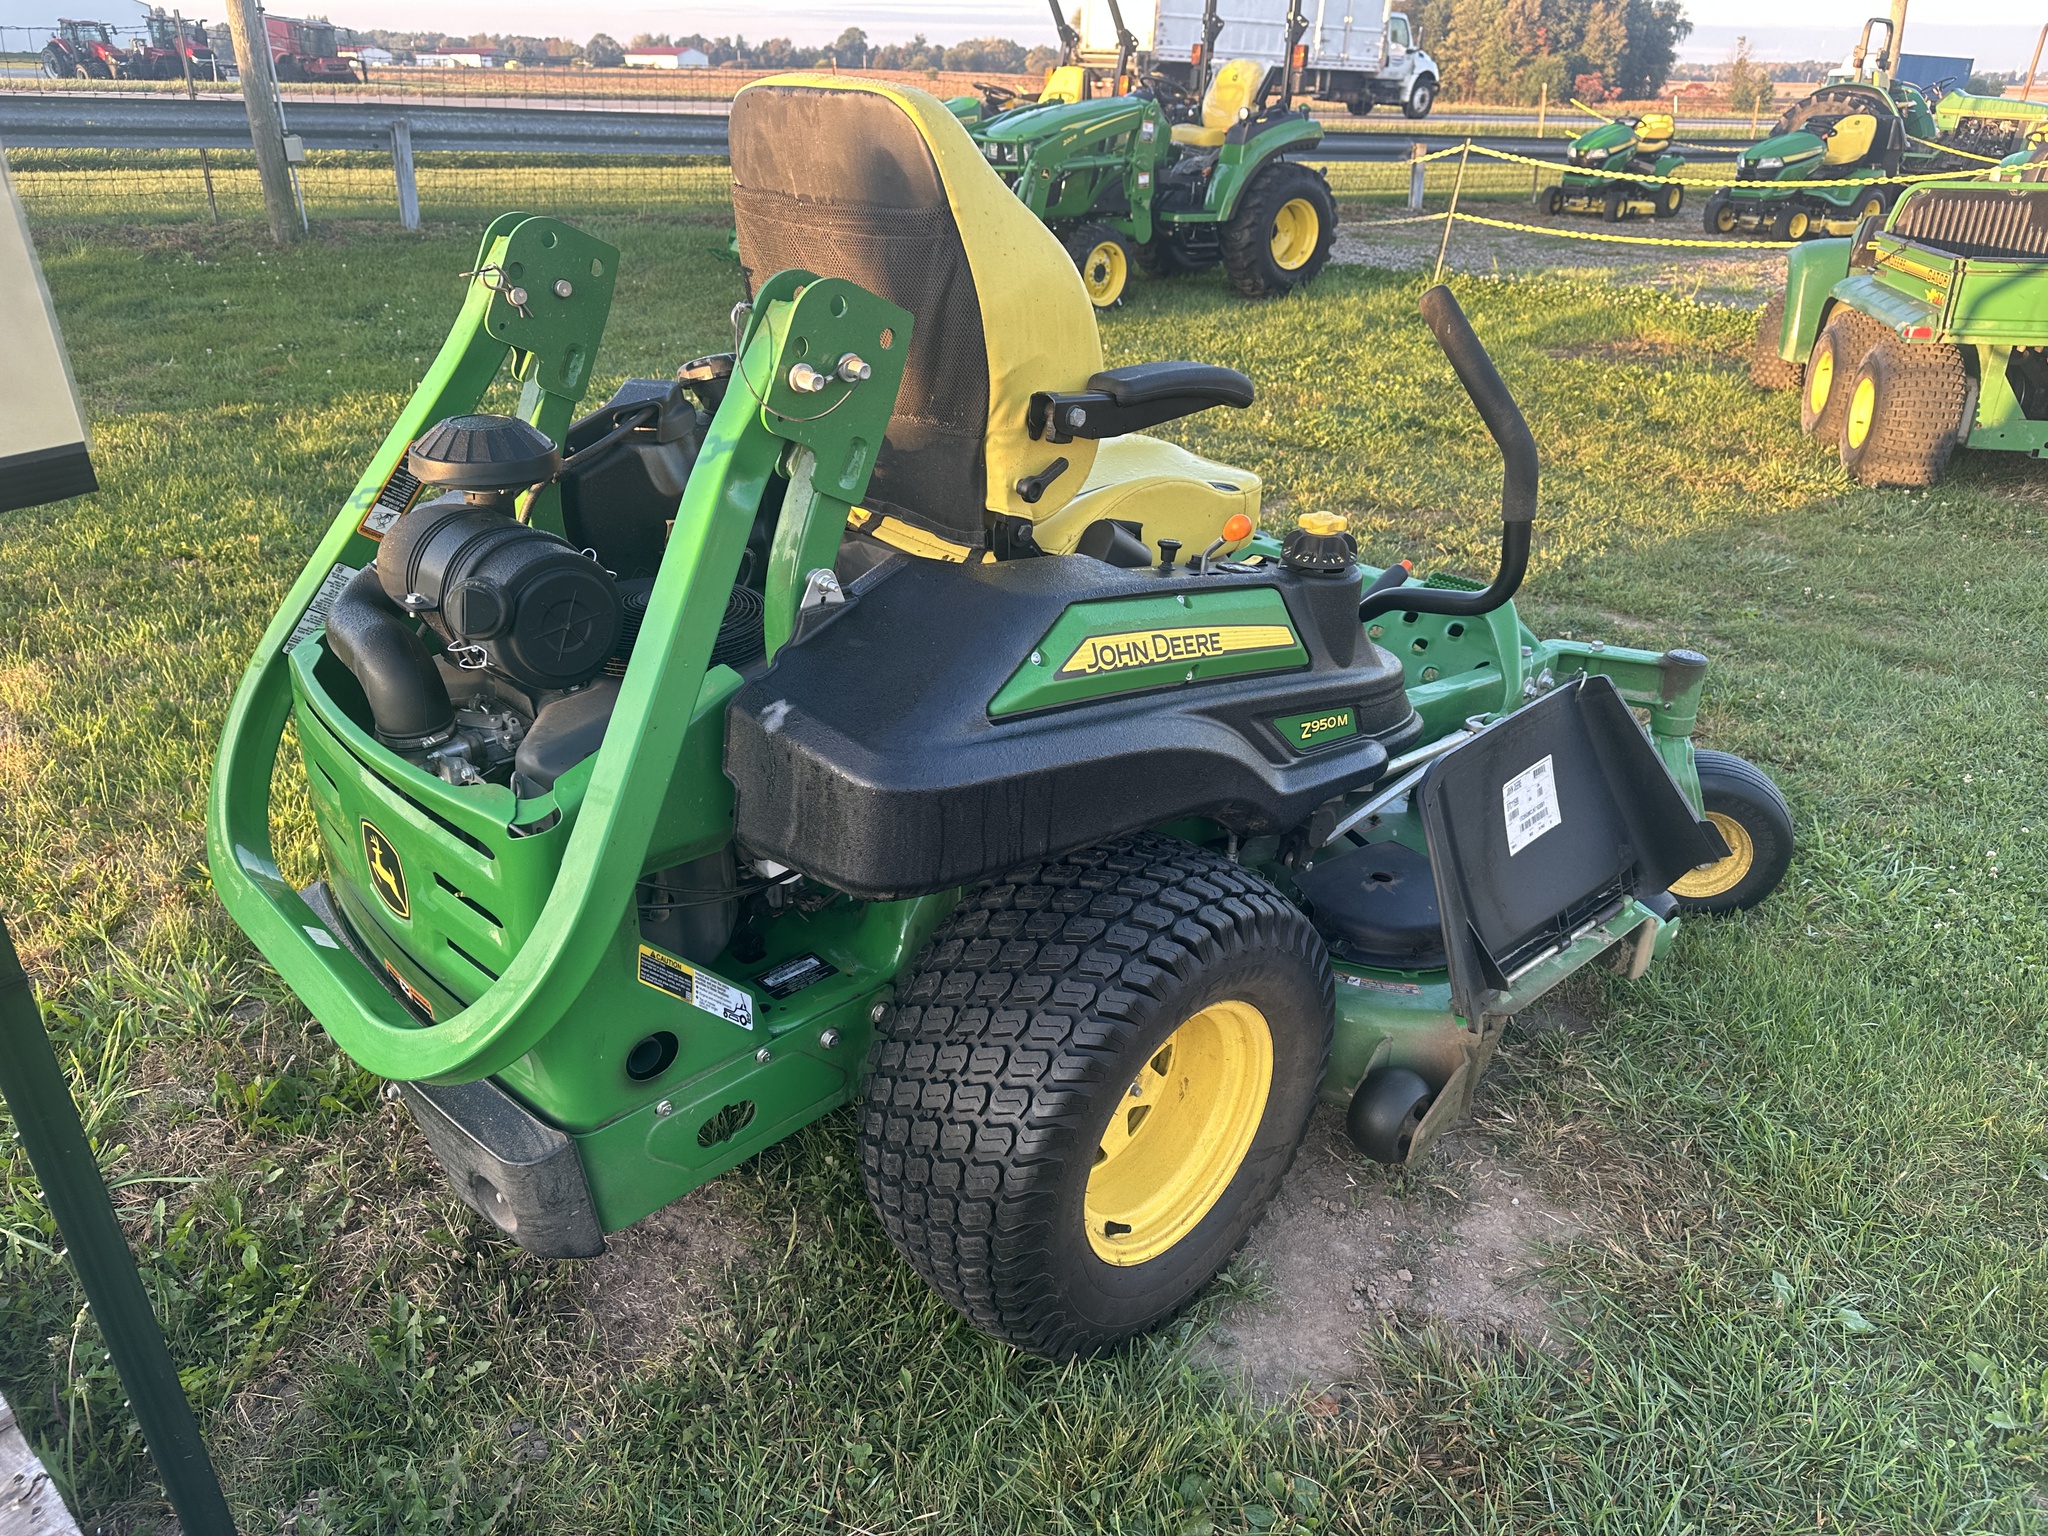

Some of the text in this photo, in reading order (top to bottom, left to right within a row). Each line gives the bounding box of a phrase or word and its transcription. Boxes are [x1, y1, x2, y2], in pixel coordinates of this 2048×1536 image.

[1927, 269, 1949, 287] GATOR
[1087, 632, 1223, 669] JOHN DEERE
[1300, 713, 1348, 739] Z950M
[656, 953, 682, 970] CAUTION
